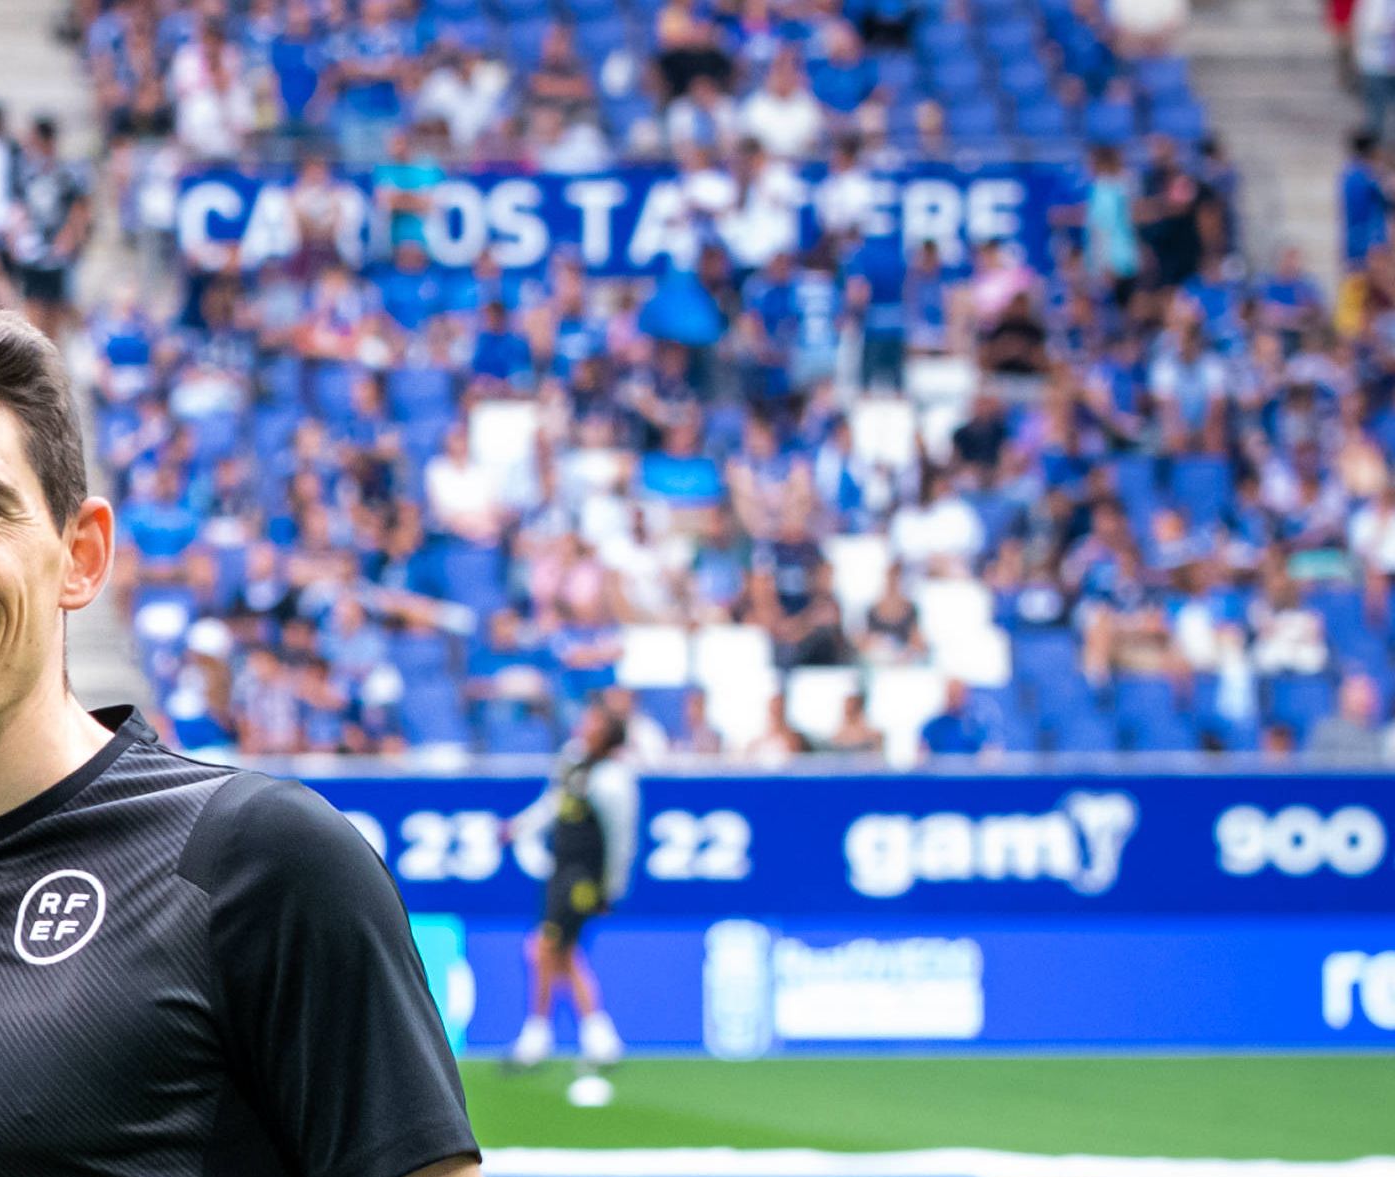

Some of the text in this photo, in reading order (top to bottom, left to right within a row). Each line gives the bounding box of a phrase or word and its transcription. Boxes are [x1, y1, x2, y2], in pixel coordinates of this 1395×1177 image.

[397, 809, 505, 881] 23
[646, 810, 752, 881] 22
[1215, 805, 1387, 875] 900
